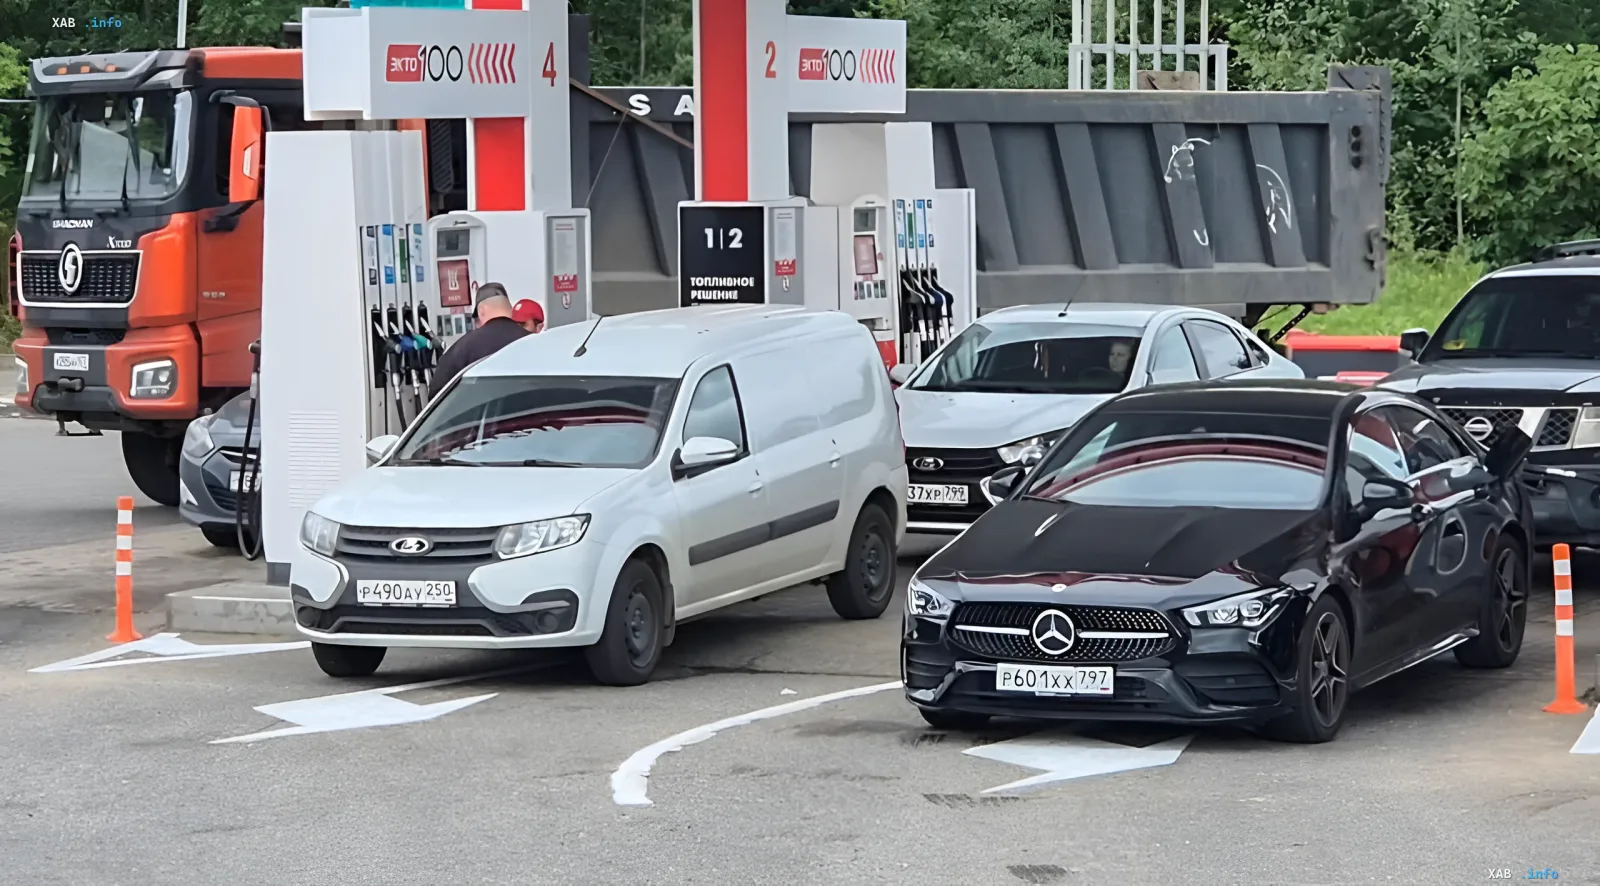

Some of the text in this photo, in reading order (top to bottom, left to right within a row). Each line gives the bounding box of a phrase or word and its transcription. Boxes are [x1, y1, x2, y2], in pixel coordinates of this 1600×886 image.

[542, 42, 557, 87] 4
[765, 41, 777, 79] 2
[426, 583, 451, 596] 250
[1078, 670, 1107, 685] 797
